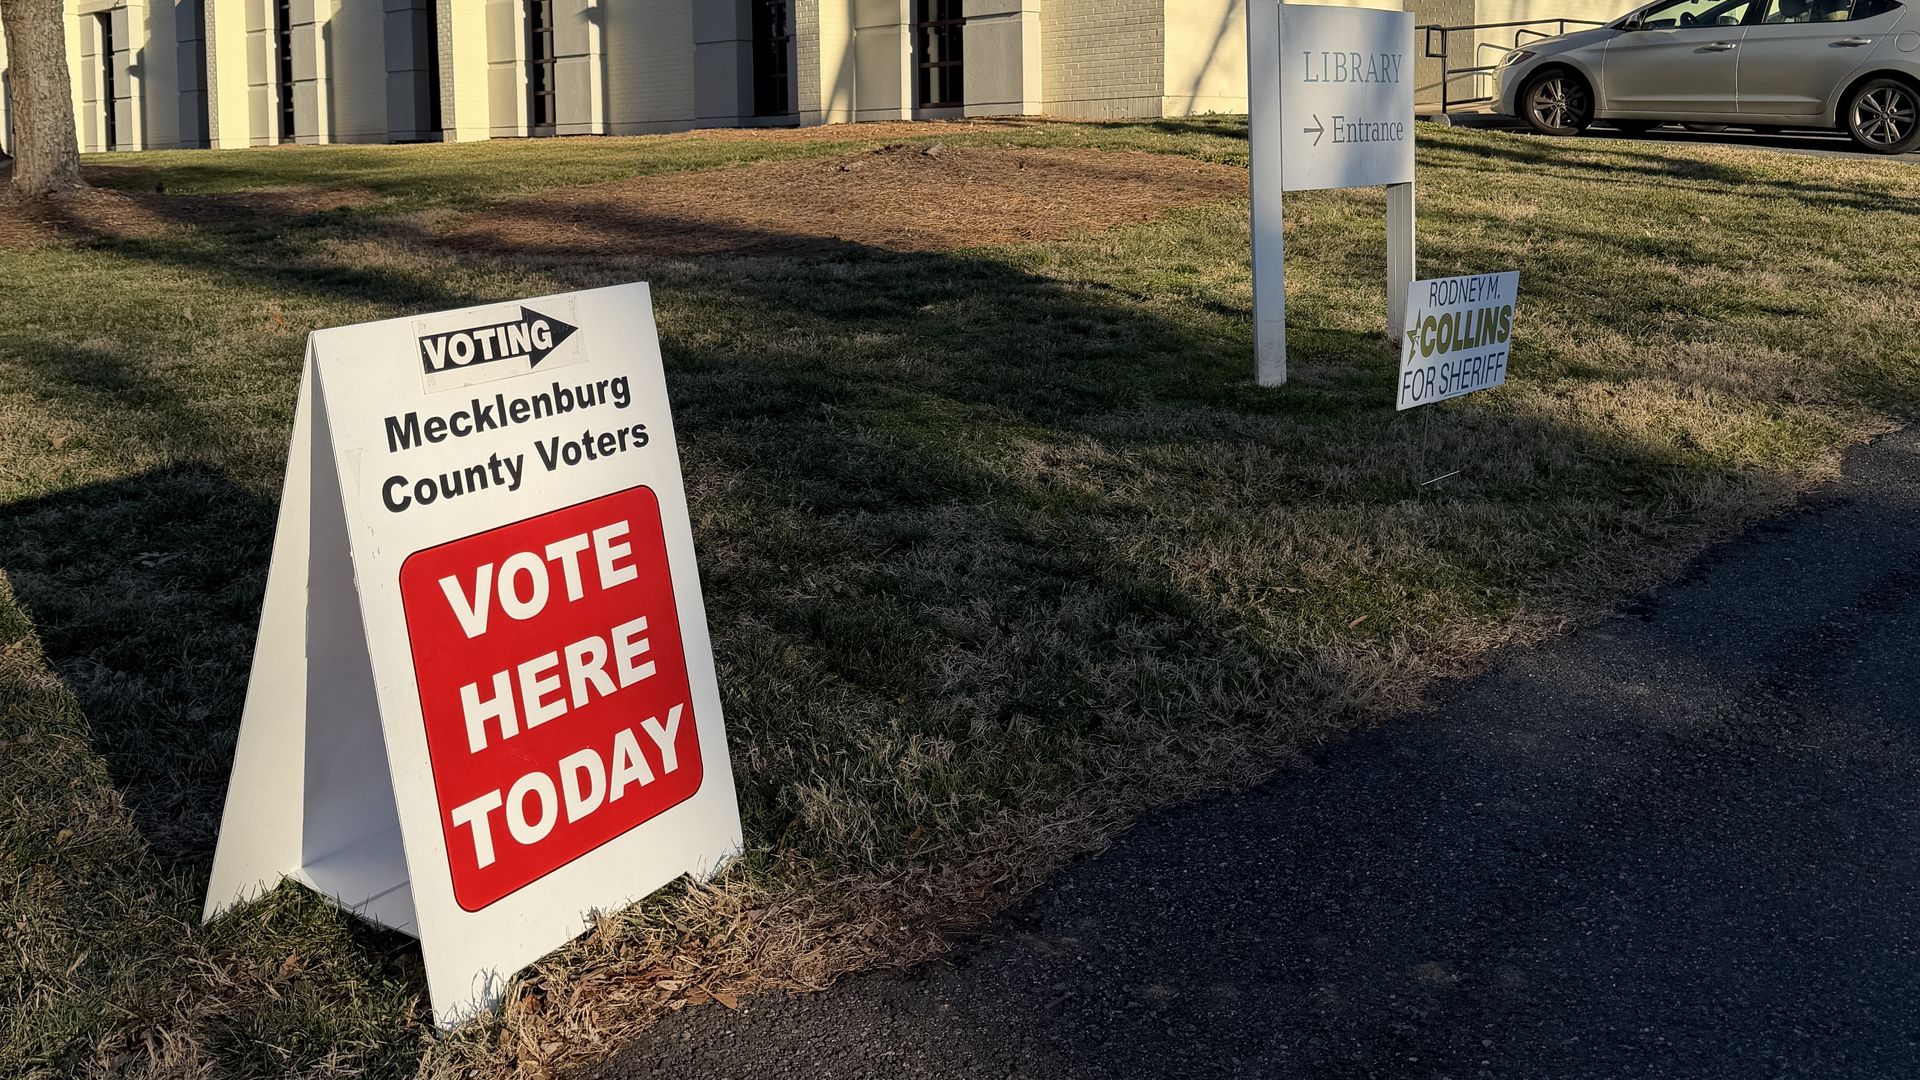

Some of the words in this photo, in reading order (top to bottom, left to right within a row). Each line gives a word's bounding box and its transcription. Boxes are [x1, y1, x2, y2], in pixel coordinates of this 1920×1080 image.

[1303, 51, 1402, 83] LIBRARY
[1332, 115, 1403, 144] Entrance
[1429, 277, 1486, 307] RODNEY
[1487, 276, 1500, 299] M.
[422, 320, 553, 370] VOTING
[1421, 305, 1511, 357] COLLINS
[1402, 366, 1435, 404] FOR
[1439, 352, 1505, 394] SHERIFF
[384, 376, 631, 453] Mecklenburg
[382, 452, 523, 513] County
[535, 423, 649, 471] Voters
[438, 520, 638, 639] VOTE
[460, 615, 656, 754] HERE
[451, 703, 684, 870] TODAY
